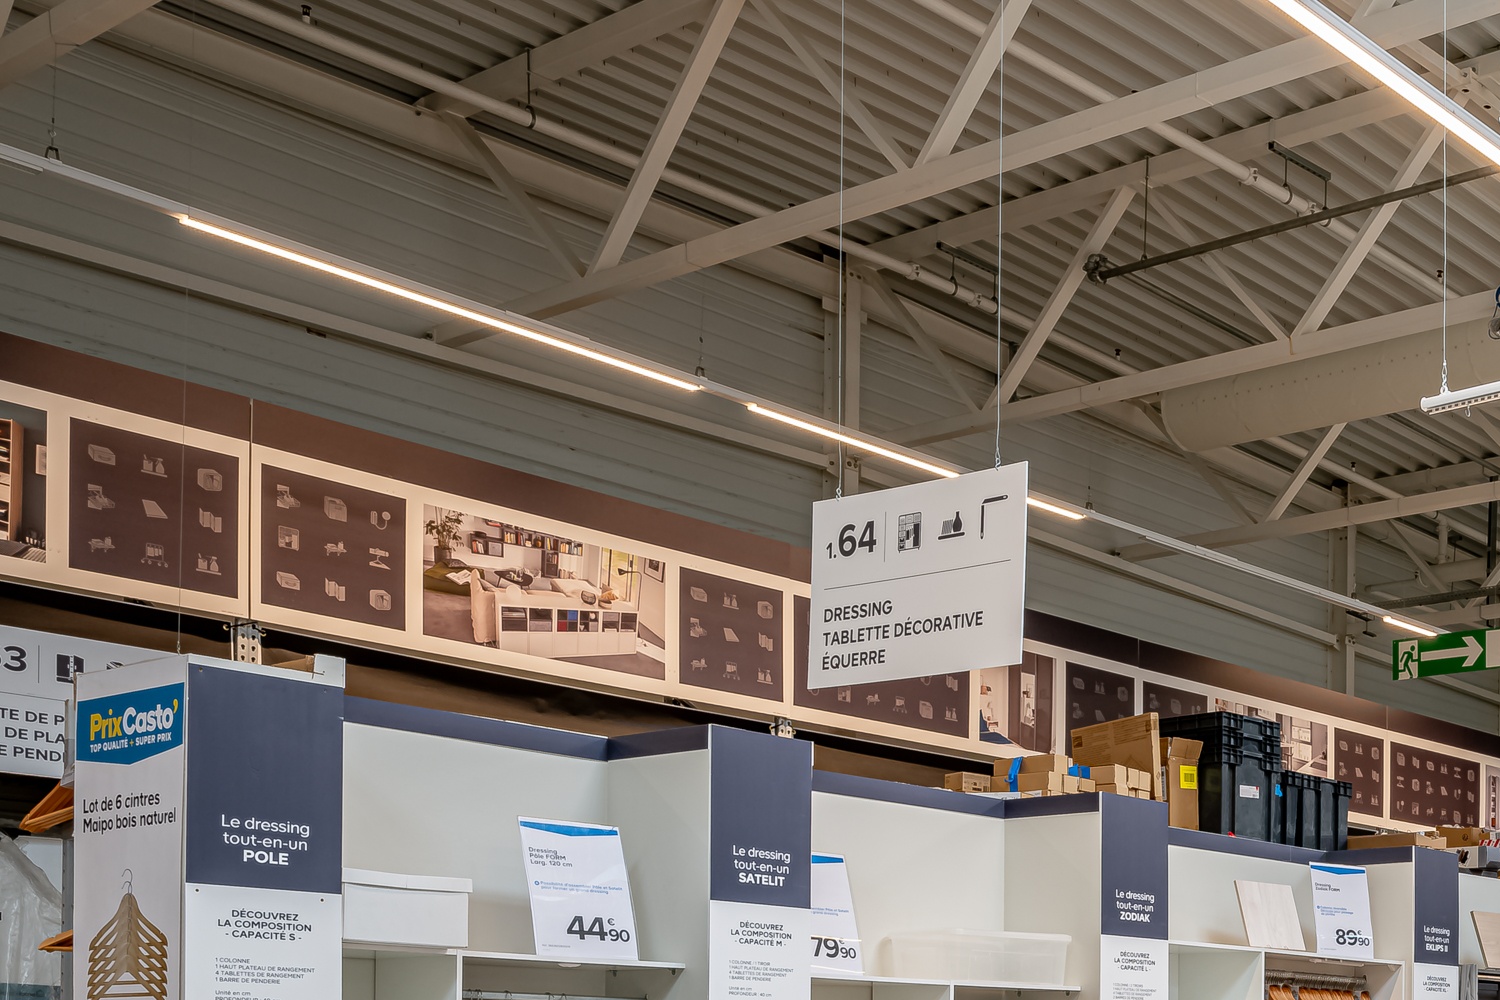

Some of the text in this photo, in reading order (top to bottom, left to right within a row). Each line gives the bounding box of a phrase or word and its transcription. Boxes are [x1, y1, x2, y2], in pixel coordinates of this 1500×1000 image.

[826, 520, 877, 559] 1.64
[823, 600, 893, 623] DRESSING
[823, 610, 984, 647] TABLETTE DÉCORATIVE
[822, 649, 886, 671] ÉQUERRE
[25, 711, 48, 725] DE
[5, 726, 29, 740] DE
[90, 732, 172, 754] TOP QUALITÉ SUPER PRIX
[83, 792, 160, 814] Lot de 6 cintres
[83, 807, 177, 835] Maipo bois naturel
[221, 814, 310, 838] Le dressing
[222, 831, 308, 851] tout-en-un
[243, 849, 289, 866] POLE
[528, 846, 558, 855] Dressing
[732, 845, 791, 863] Le dressing
[734, 858, 790, 874] tout-en-un
[738, 872, 785, 887] SATELIT
[1115, 889, 1155, 903] Le dressing
[1116, 900, 1154, 912] tout-en-un
[231, 908, 299, 922] DÉCOUVREZ
[1120, 911, 1150, 923] ZODIAK
[217, 919, 312, 933] LA COMPOSITION
[739, 920, 784, 931] DÉCOUVREZ
[1424, 925, 1450, 937] Le dressing
[231, 930, 296, 941] CAPACITÉ S
[741, 929, 792, 940] COMPOSITION
[1424, 935, 1449, 944] tout-en-un
[739, 937, 783, 947] CAPACITÉ M
[1426, 943, 1443, 952] EKLIPS
[1120, 950, 1150, 959] DÉCOUVREZ
[1121, 958, 1155, 966] COMPOSITION
[277, 966, 315, 974] RANGEMENT
